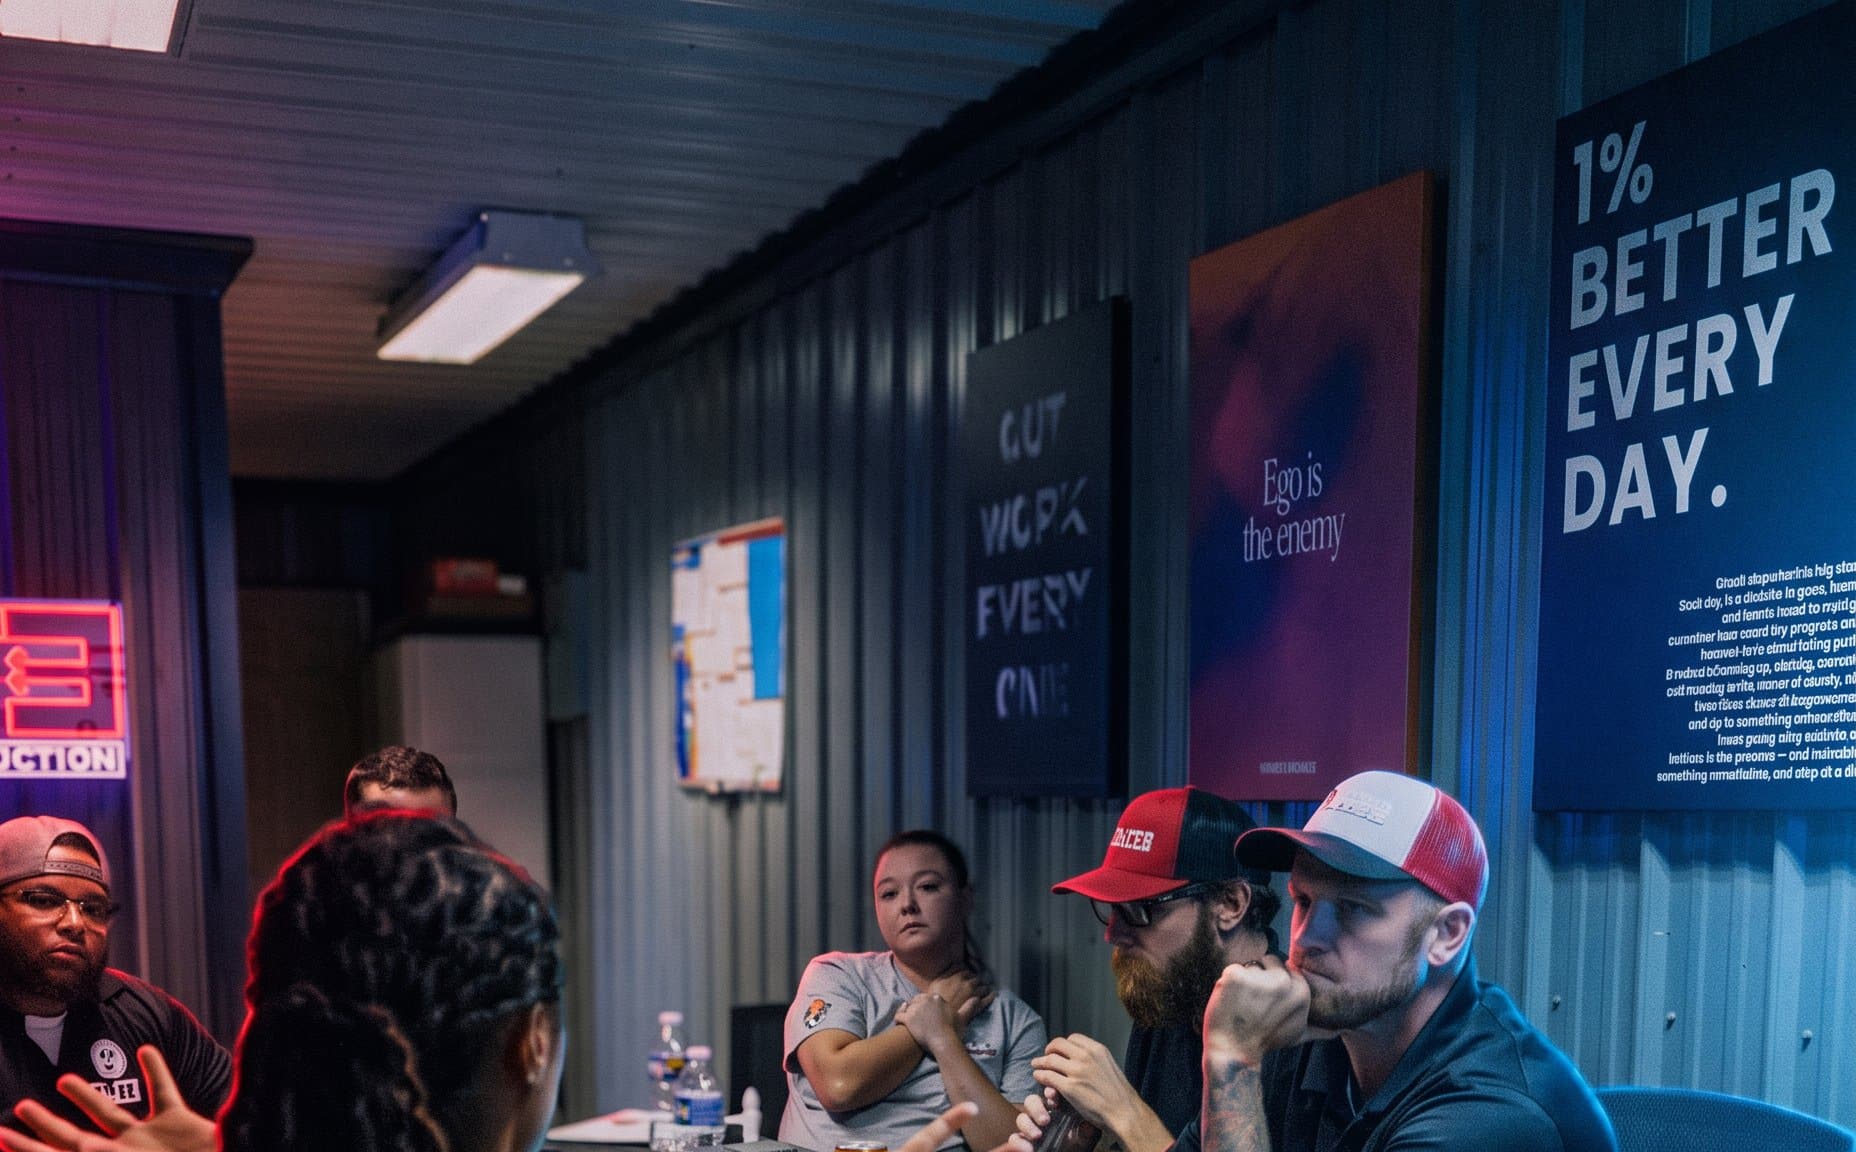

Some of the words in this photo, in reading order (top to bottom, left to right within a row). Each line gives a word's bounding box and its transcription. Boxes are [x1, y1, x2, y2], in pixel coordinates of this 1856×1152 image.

[1573, 120, 1653, 224] 1%
[1570, 168, 1836, 330] BETTER
[1567, 293, 1795, 432] EVERY
[1264, 457, 1302, 516] Ego
[1307, 450, 1323, 498] is
[1563, 427, 1727, 534] DAY.
[1243, 515, 1273, 562] the
[1276, 512, 1345, 562] enemy
[1808, 601, 1821, 615] to
[1724, 715, 1735, 729] to
[1736, 712, 1792, 729] something
[1656, 768, 1708, 785] something
[1716, 750, 1733, 763] the
